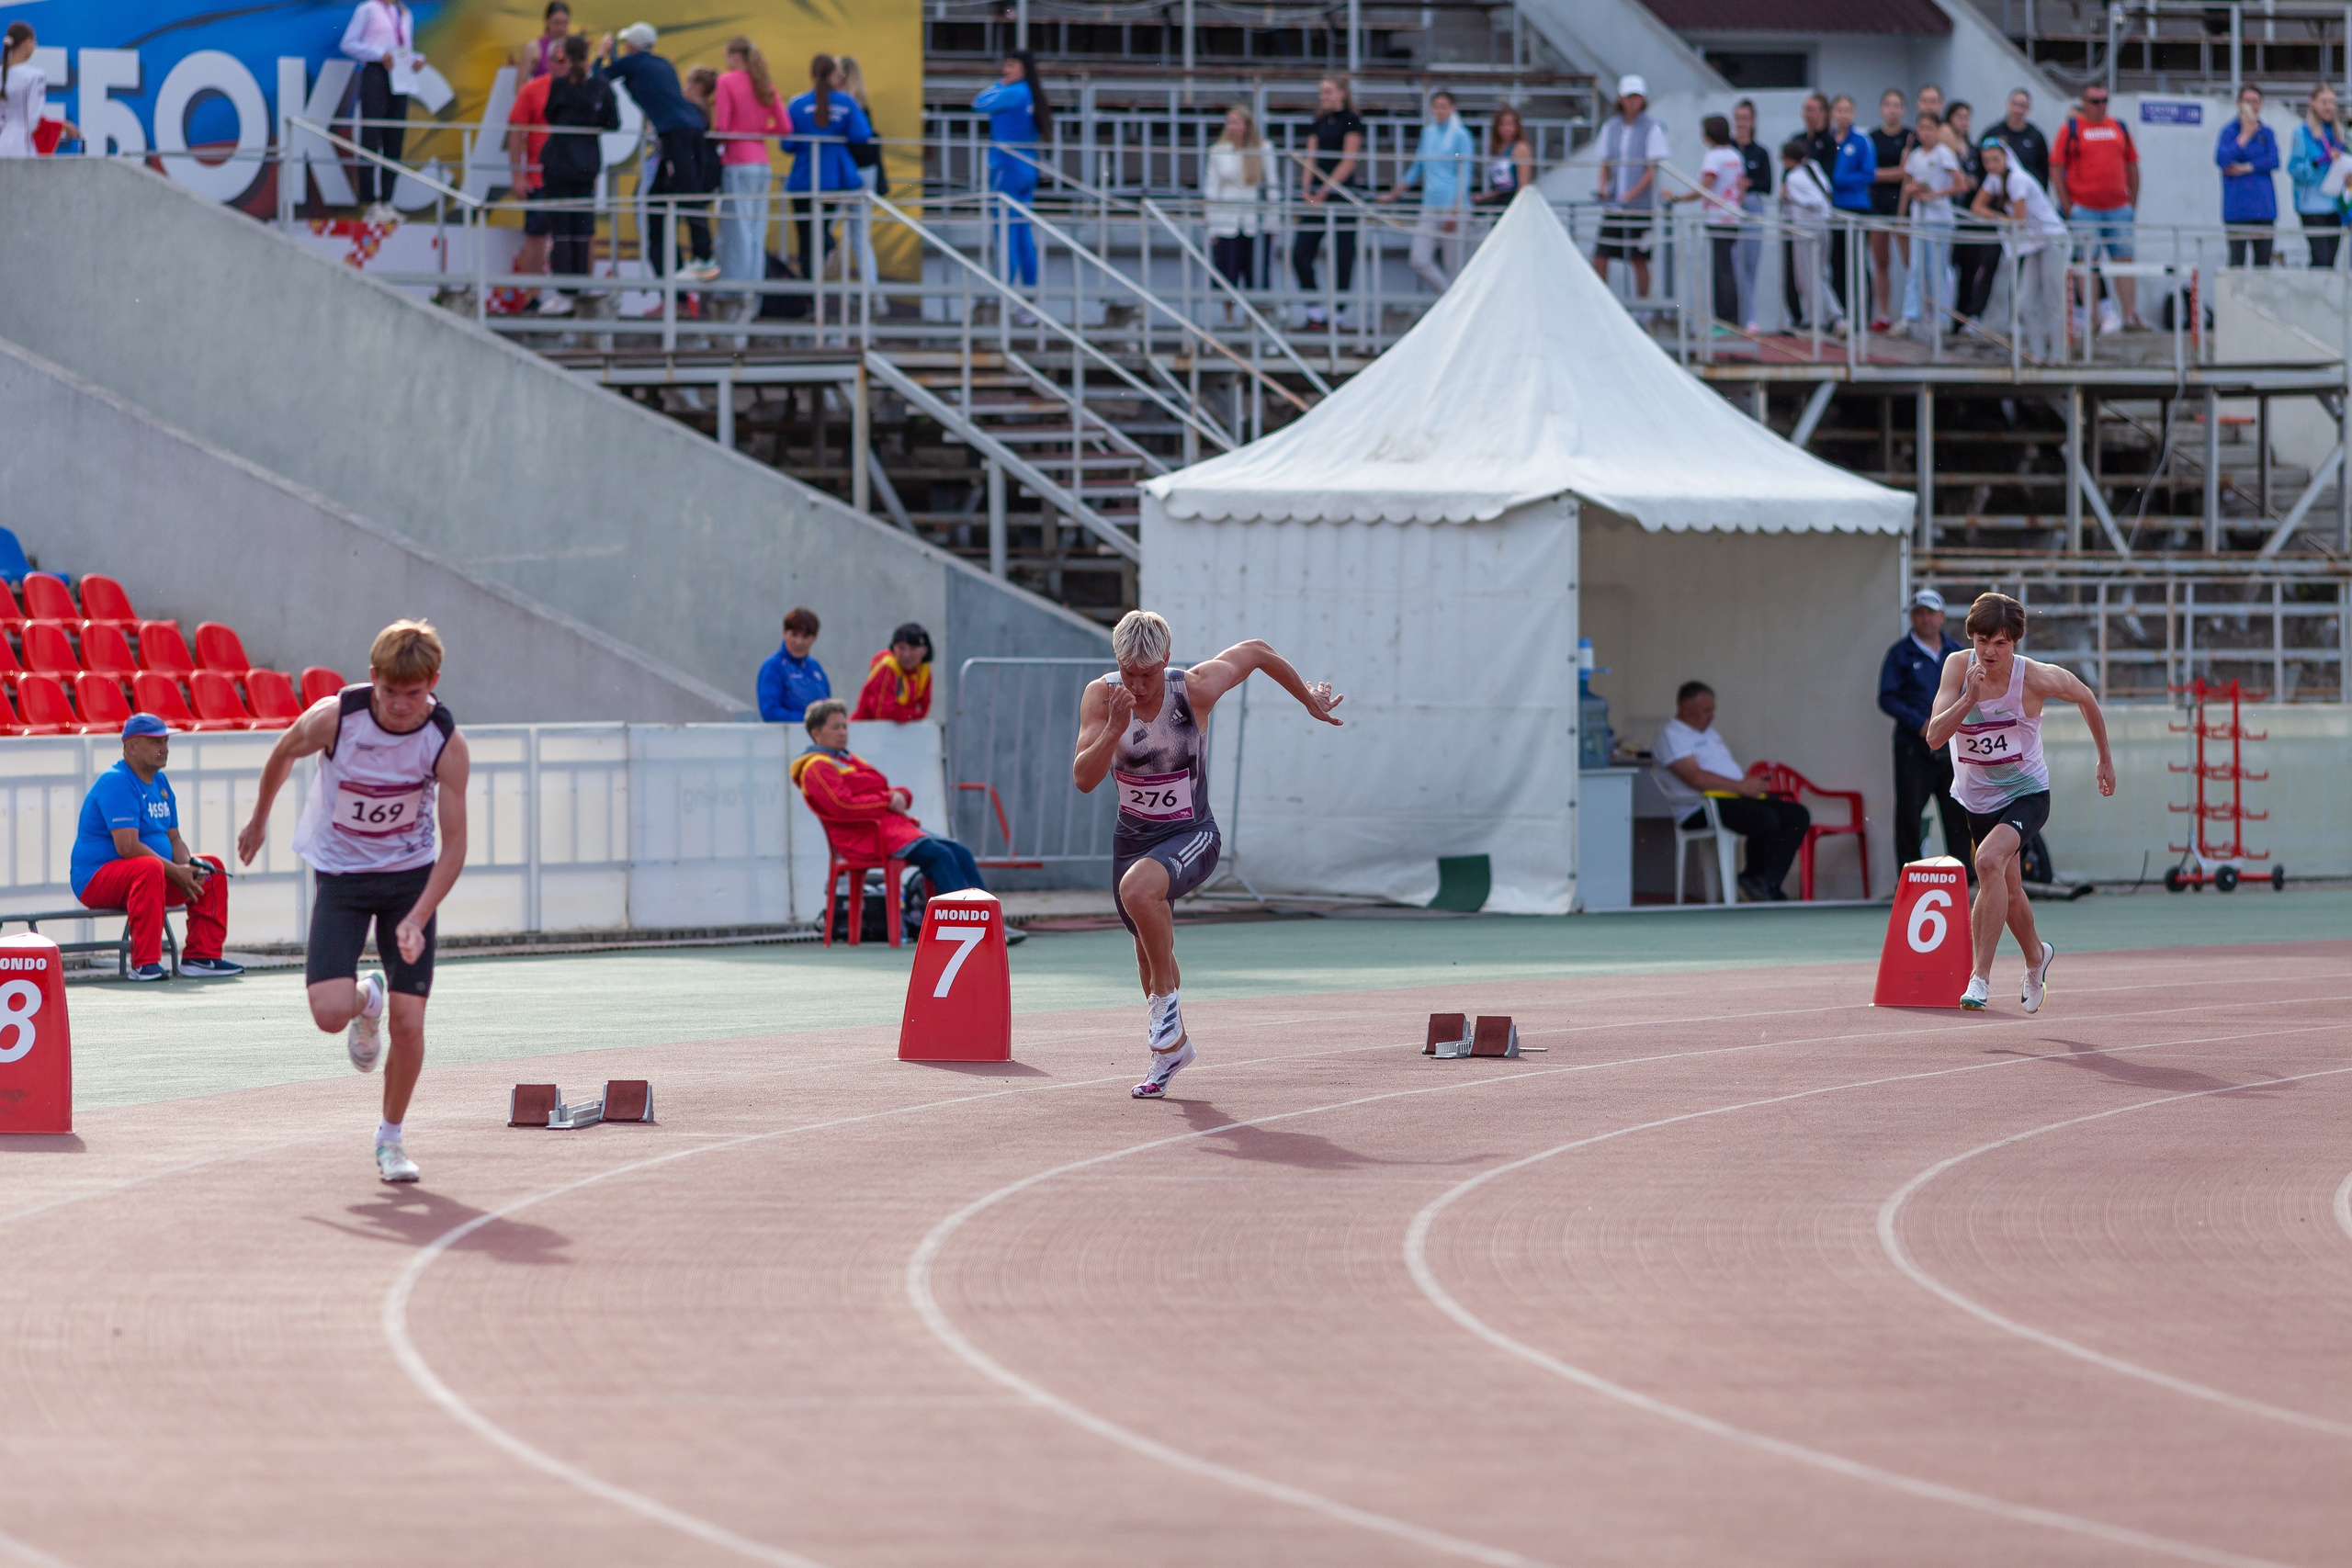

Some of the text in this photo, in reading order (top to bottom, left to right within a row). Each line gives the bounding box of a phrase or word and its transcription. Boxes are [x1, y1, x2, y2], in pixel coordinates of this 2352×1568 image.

[1966, 735, 2007, 754] 234
[1130, 790, 1177, 807] 276
[352, 801, 404, 823] 169
[1908, 872, 1957, 884] MONDO
[934, 908, 989, 921] MONDO
[1907, 888, 1952, 953] 6
[933, 926, 987, 998] 7
[0, 978, 42, 1064] 8
